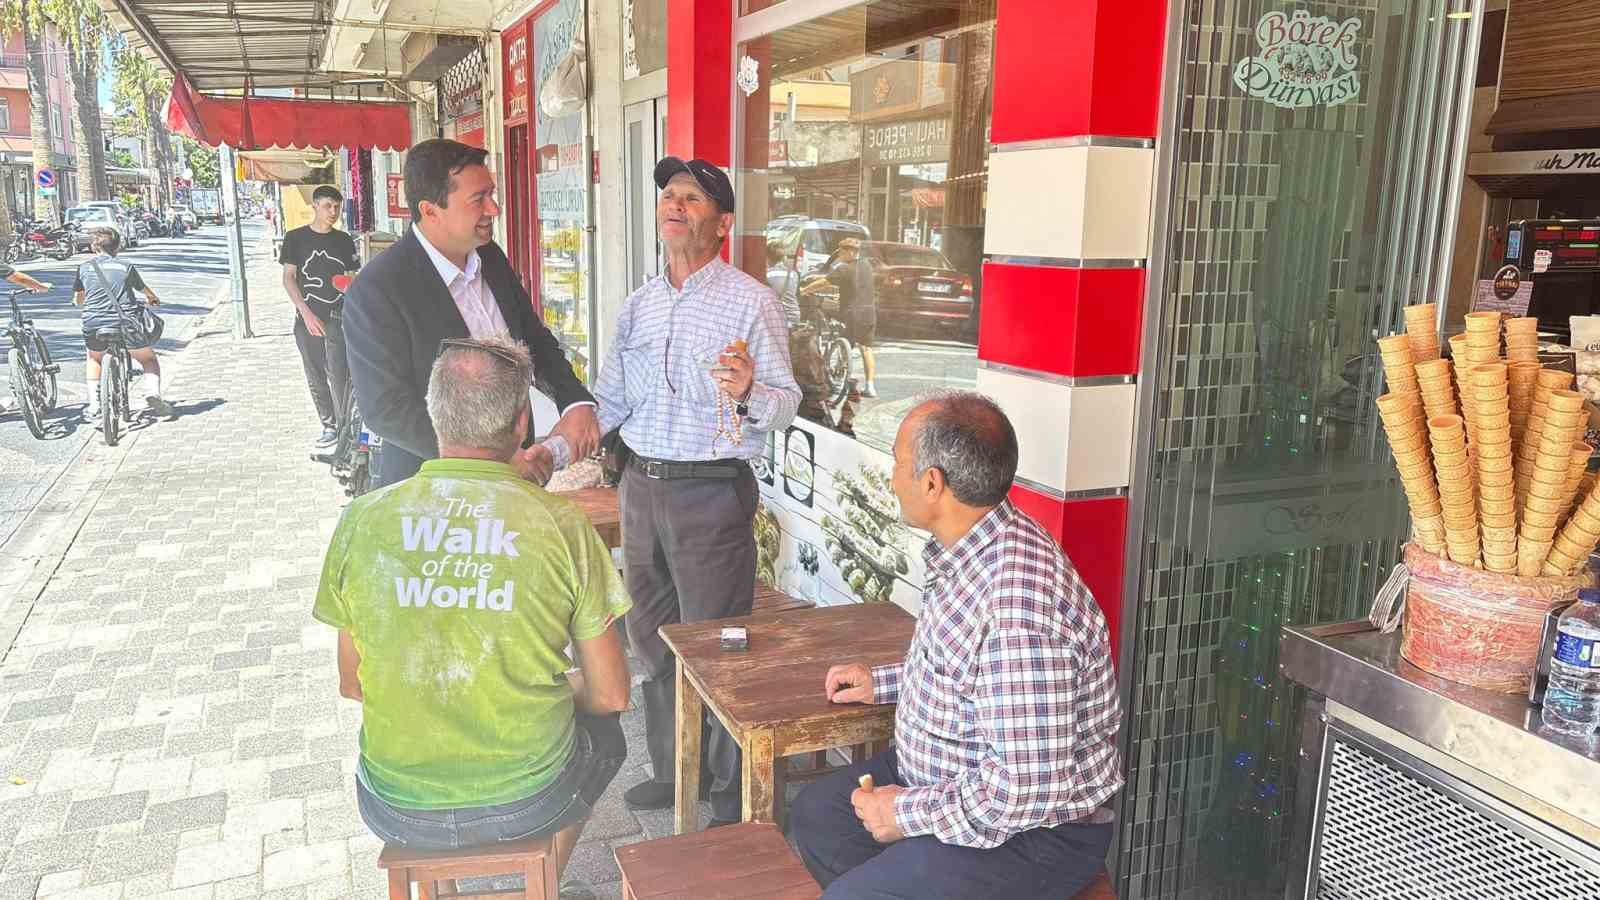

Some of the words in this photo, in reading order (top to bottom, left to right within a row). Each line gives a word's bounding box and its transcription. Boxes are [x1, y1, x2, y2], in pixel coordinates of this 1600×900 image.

[1259, 13, 1359, 64] Börek
[444, 497, 489, 518] The
[401, 516, 521, 557] Walk
[422, 555, 449, 577] of
[454, 557, 494, 579] the
[395, 577, 514, 612] World
